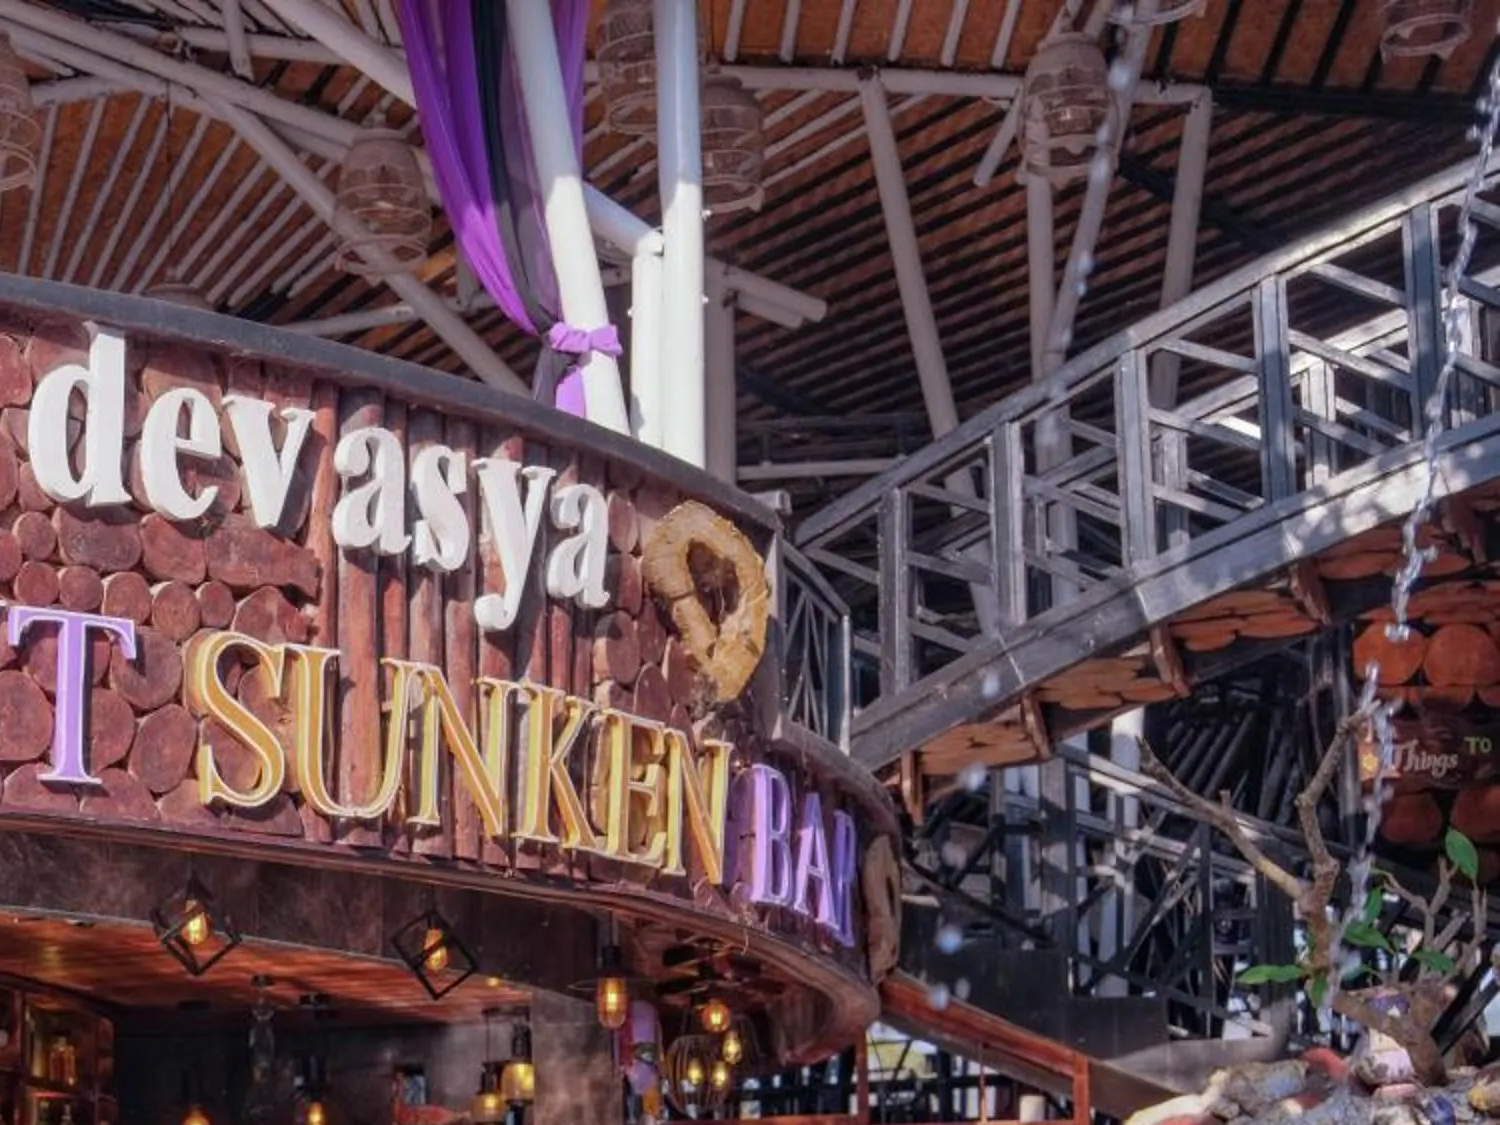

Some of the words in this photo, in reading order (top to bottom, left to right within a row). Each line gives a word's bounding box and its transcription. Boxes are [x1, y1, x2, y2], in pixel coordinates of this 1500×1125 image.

[26, 322, 612, 631] devasya
[186, 632, 732, 885] SUNKEN
[748, 763, 857, 948] BAR
[1392, 739, 1459, 778] Things
